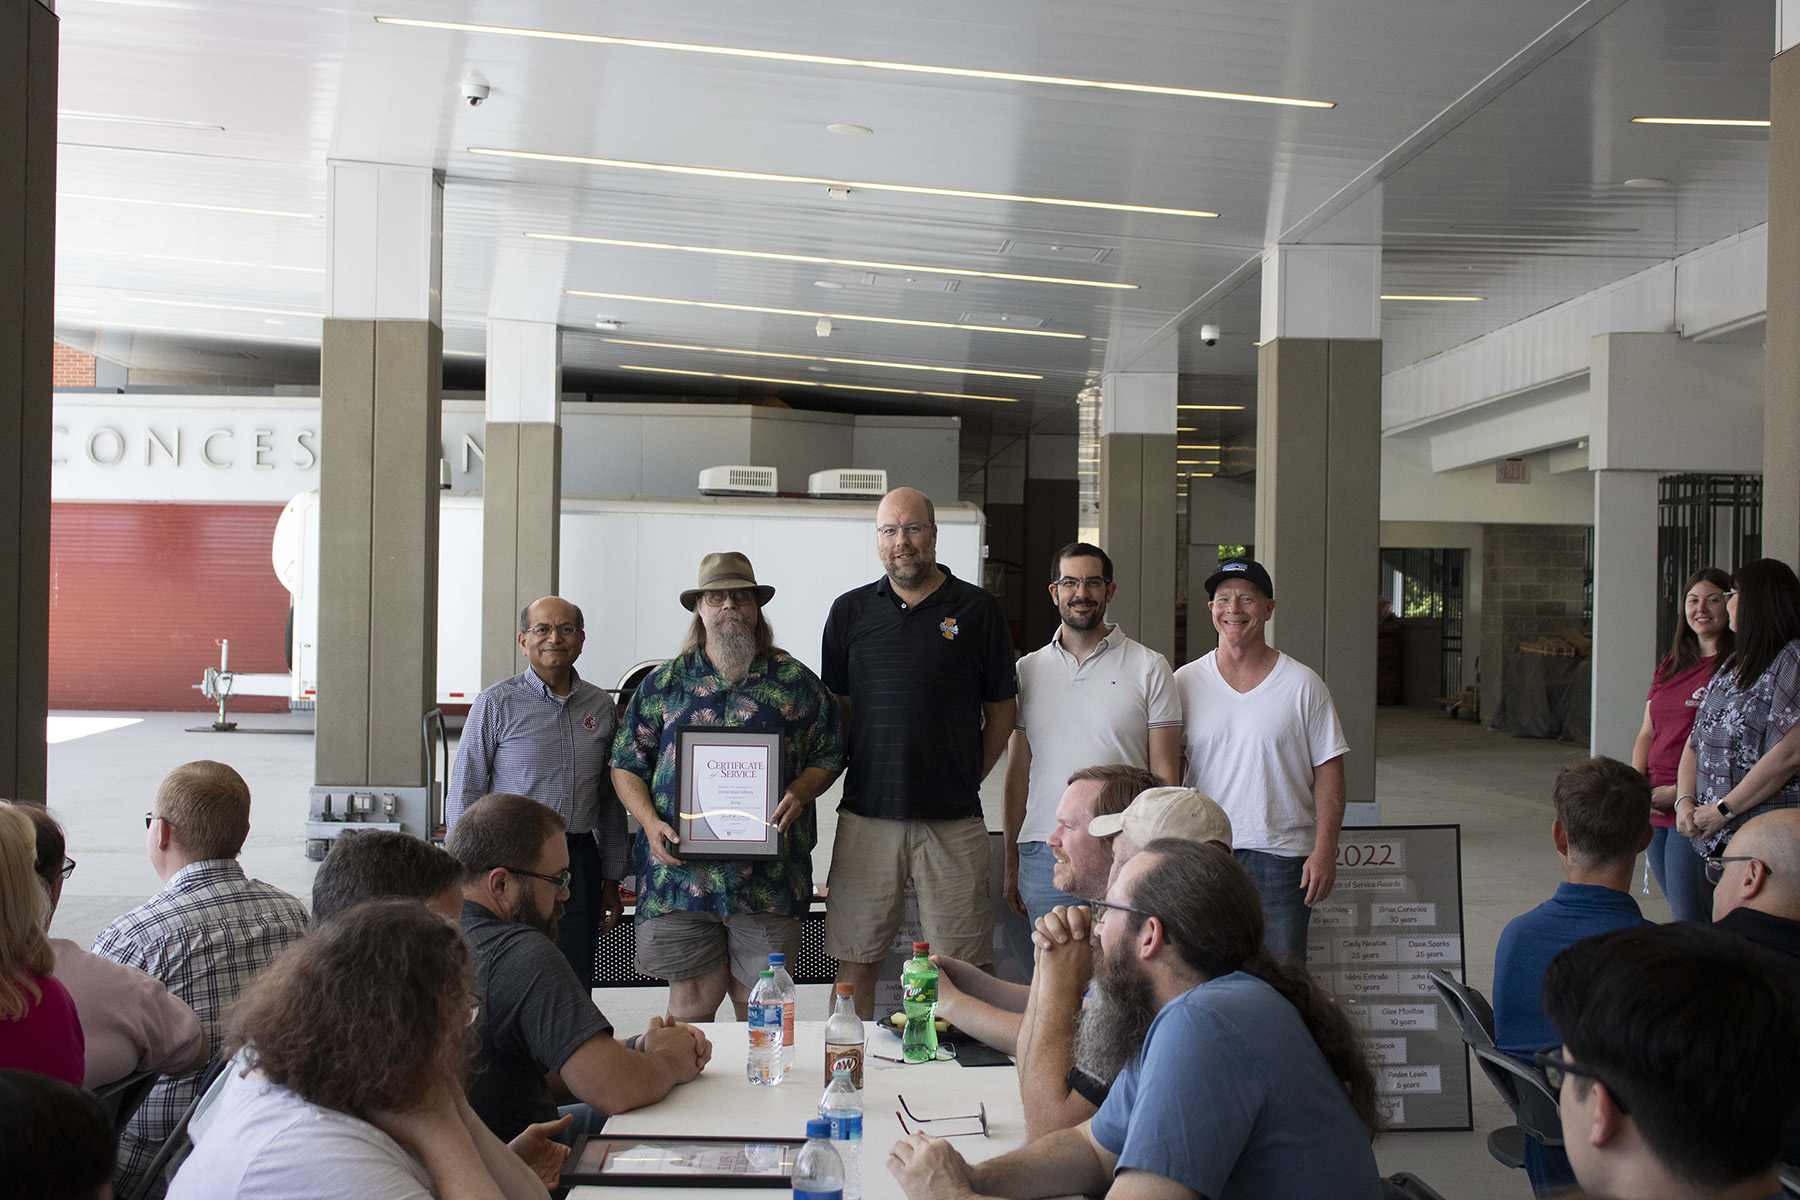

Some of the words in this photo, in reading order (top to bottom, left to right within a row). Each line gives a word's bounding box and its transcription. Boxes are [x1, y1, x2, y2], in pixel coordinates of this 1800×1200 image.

[706, 759, 765, 770] CERTIFICATE
[720, 769, 758, 778] SERVICE
[1344, 880, 1351, 888] of
[1352, 880, 1376, 889] Service
[1377, 880, 1401, 888] Awards
[1379, 905, 1397, 913] Brian
[1397, 905, 1427, 913] Cornelius
[1322, 917, 1340, 925] years
[1400, 915, 1417, 925] years
[1342, 940, 1361, 949] Cindy
[1408, 940, 1427, 948] Dawn
[1428, 940, 1450, 949] Sparks
[1362, 952, 1379, 961] years
[1427, 951, 1444, 960] years
[1344, 973, 1363, 981] Isidro
[1353, 983, 1363, 991] 10
[1364, 983, 1380, 992] years
[1417, 982, 1427, 991] 10
[1382, 1007, 1399, 1015] Glen
[1399, 1018, 1417, 1027] years
[1375, 1042, 1395, 1050] Snook
[1409, 1070, 1428, 1078] Lewis
[1403, 1081, 1420, 1089] years
